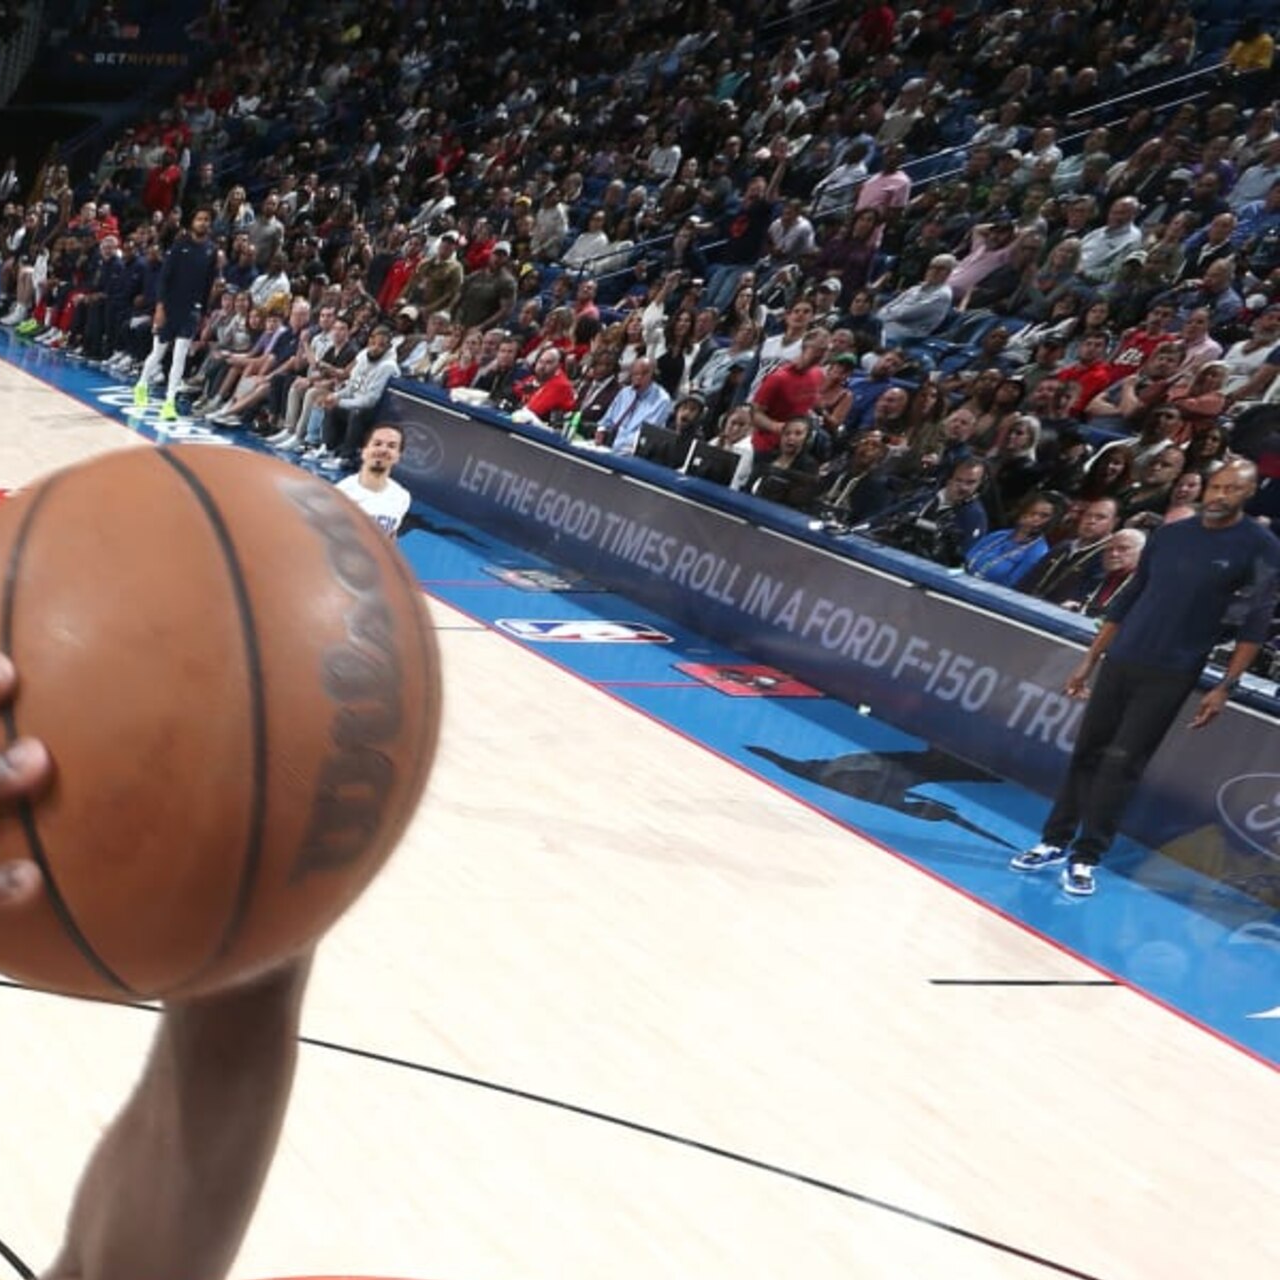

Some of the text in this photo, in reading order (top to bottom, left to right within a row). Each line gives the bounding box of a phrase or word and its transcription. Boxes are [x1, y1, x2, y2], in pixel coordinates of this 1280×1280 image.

[458, 455, 498, 496] LET
[494, 470, 538, 515] THE
[535, 488, 601, 540] GOOD
[599, 512, 677, 574] TIMES
[670, 545, 741, 605] ROLL
[740, 572, 783, 619] IN
[772, 589, 804, 632] A
[801, 598, 898, 669] FORD
